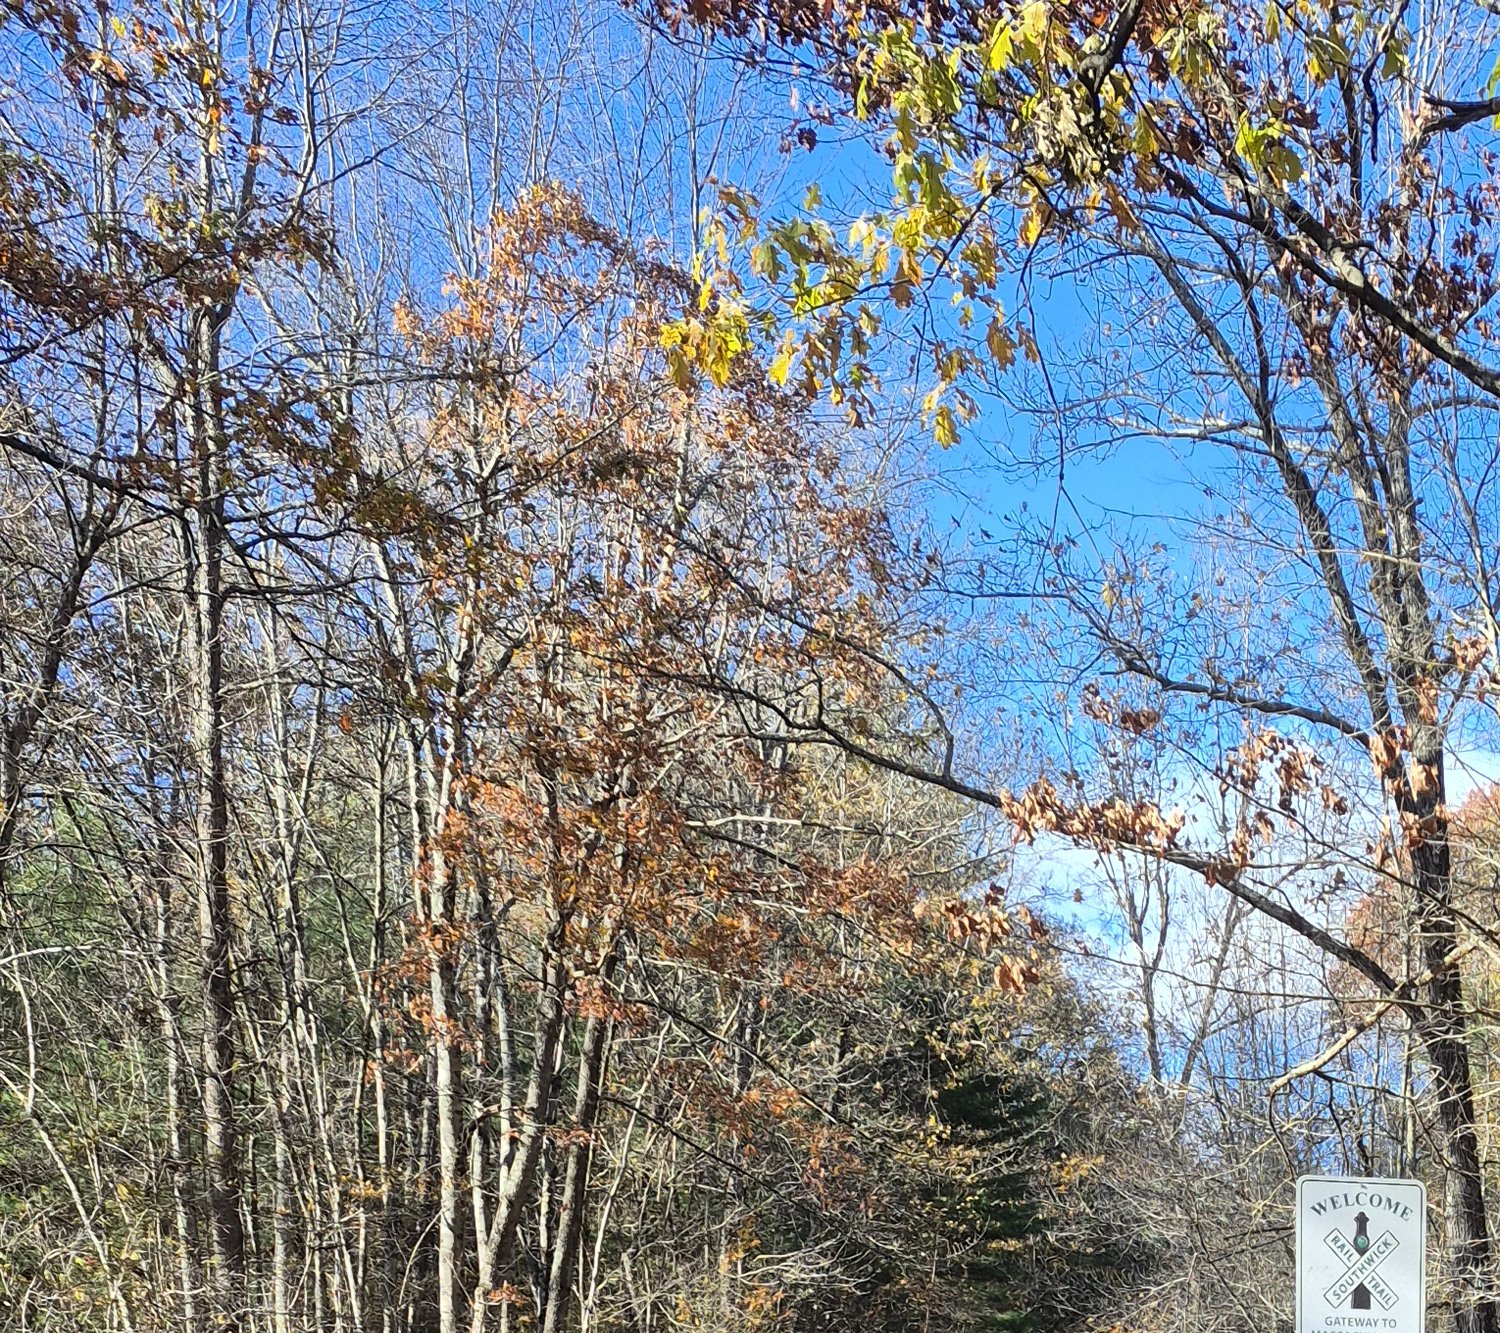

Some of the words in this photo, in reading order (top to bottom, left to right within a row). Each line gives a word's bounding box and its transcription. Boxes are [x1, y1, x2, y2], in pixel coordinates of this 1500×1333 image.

[1310, 1192, 1414, 1221] WELCOME
[1330, 1235, 1355, 1263] RAIL
[1332, 1237, 1392, 1300] SOUTHWICK
[1367, 1275, 1392, 1309] TRAIL
[1324, 1316, 1379, 1328] GATEWAY
[1382, 1319, 1397, 1328] TO
